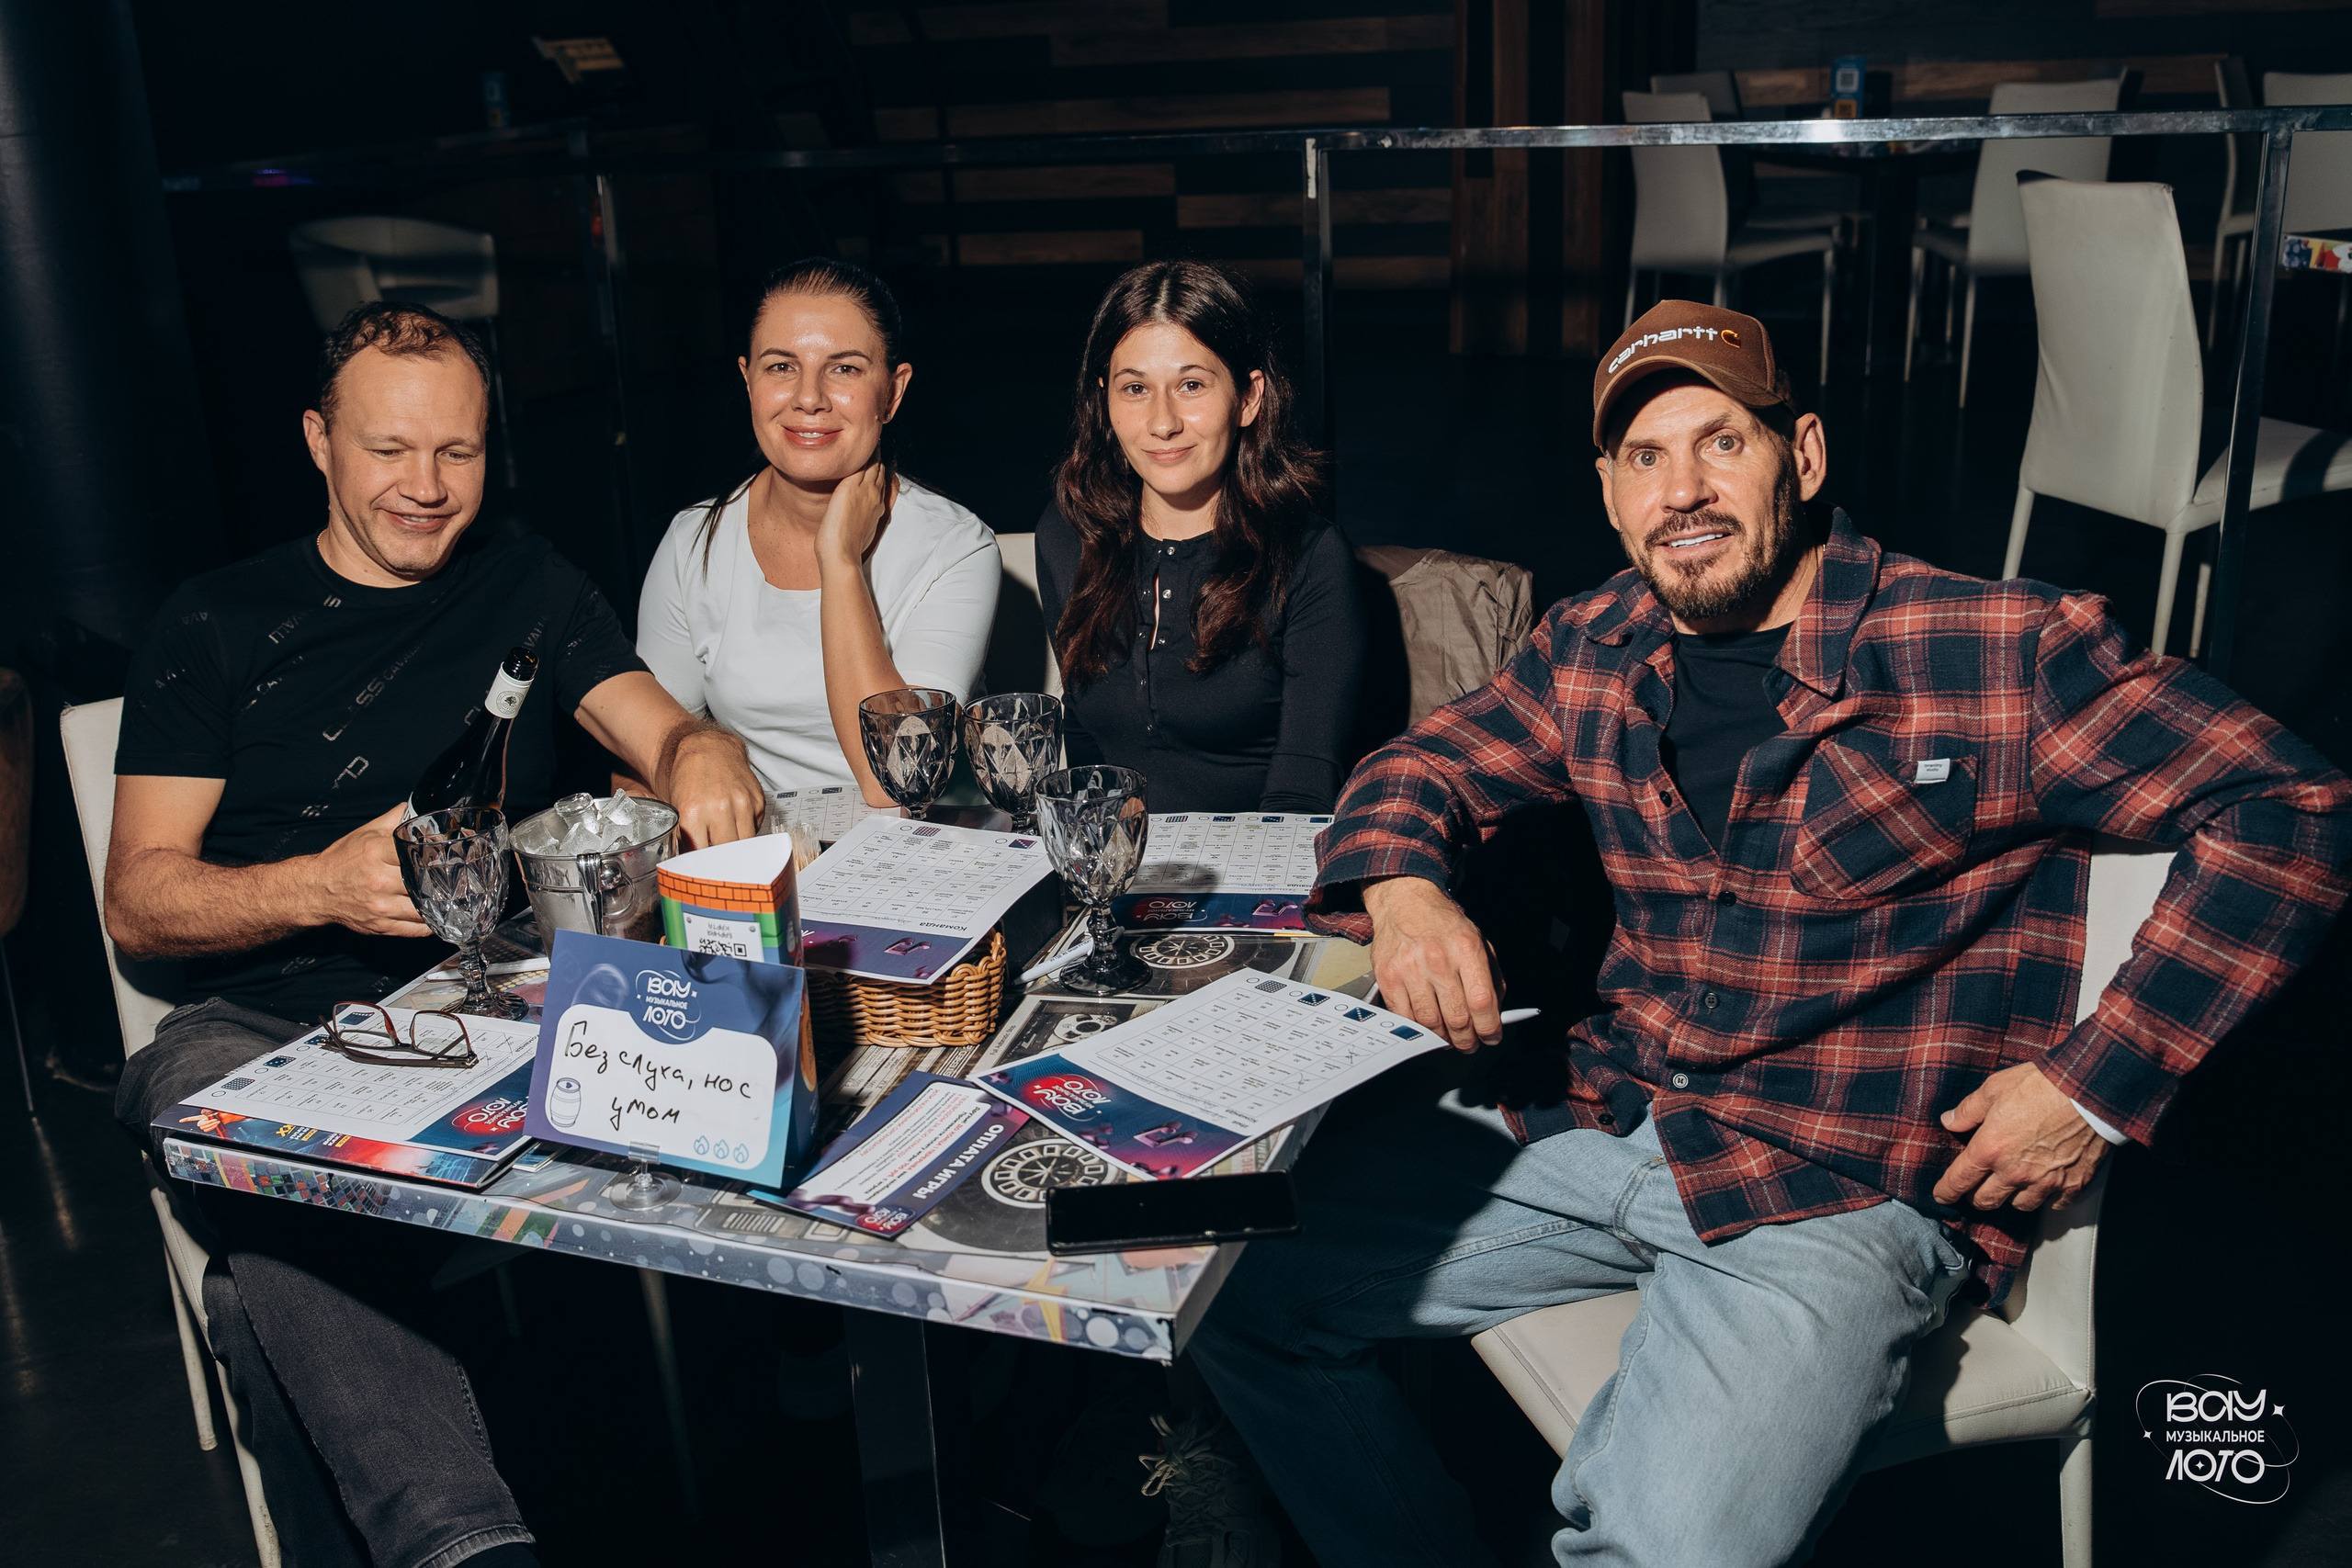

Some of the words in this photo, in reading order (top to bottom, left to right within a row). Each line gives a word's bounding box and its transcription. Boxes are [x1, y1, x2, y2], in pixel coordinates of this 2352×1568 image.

[1608, 326, 1718, 374] carhartt
[1149, 901, 1197, 909] ЛОТО
[920, 921, 967, 932] Команда
[647, 976, 692, 998] ВАУ
[646, 996, 688, 1009] МУЗЫКАЛЬНОЕ
[643, 1006, 686, 1029] ЛОТО
[564, 1021, 608, 1074] Без
[1033, 1087, 1085, 1114] ВАУ
[1051, 1084, 1094, 1109] МУЗЫКАЛЬНОЕ
[1062, 1079, 1111, 1104] ЛОТО
[467, 1096, 510, 1122] ЛОТО
[610, 1097, 680, 1131] умом
[947, 1123, 1005, 1168] ОПЛАТА
[911, 1168, 956, 1200] ИГРЫ
